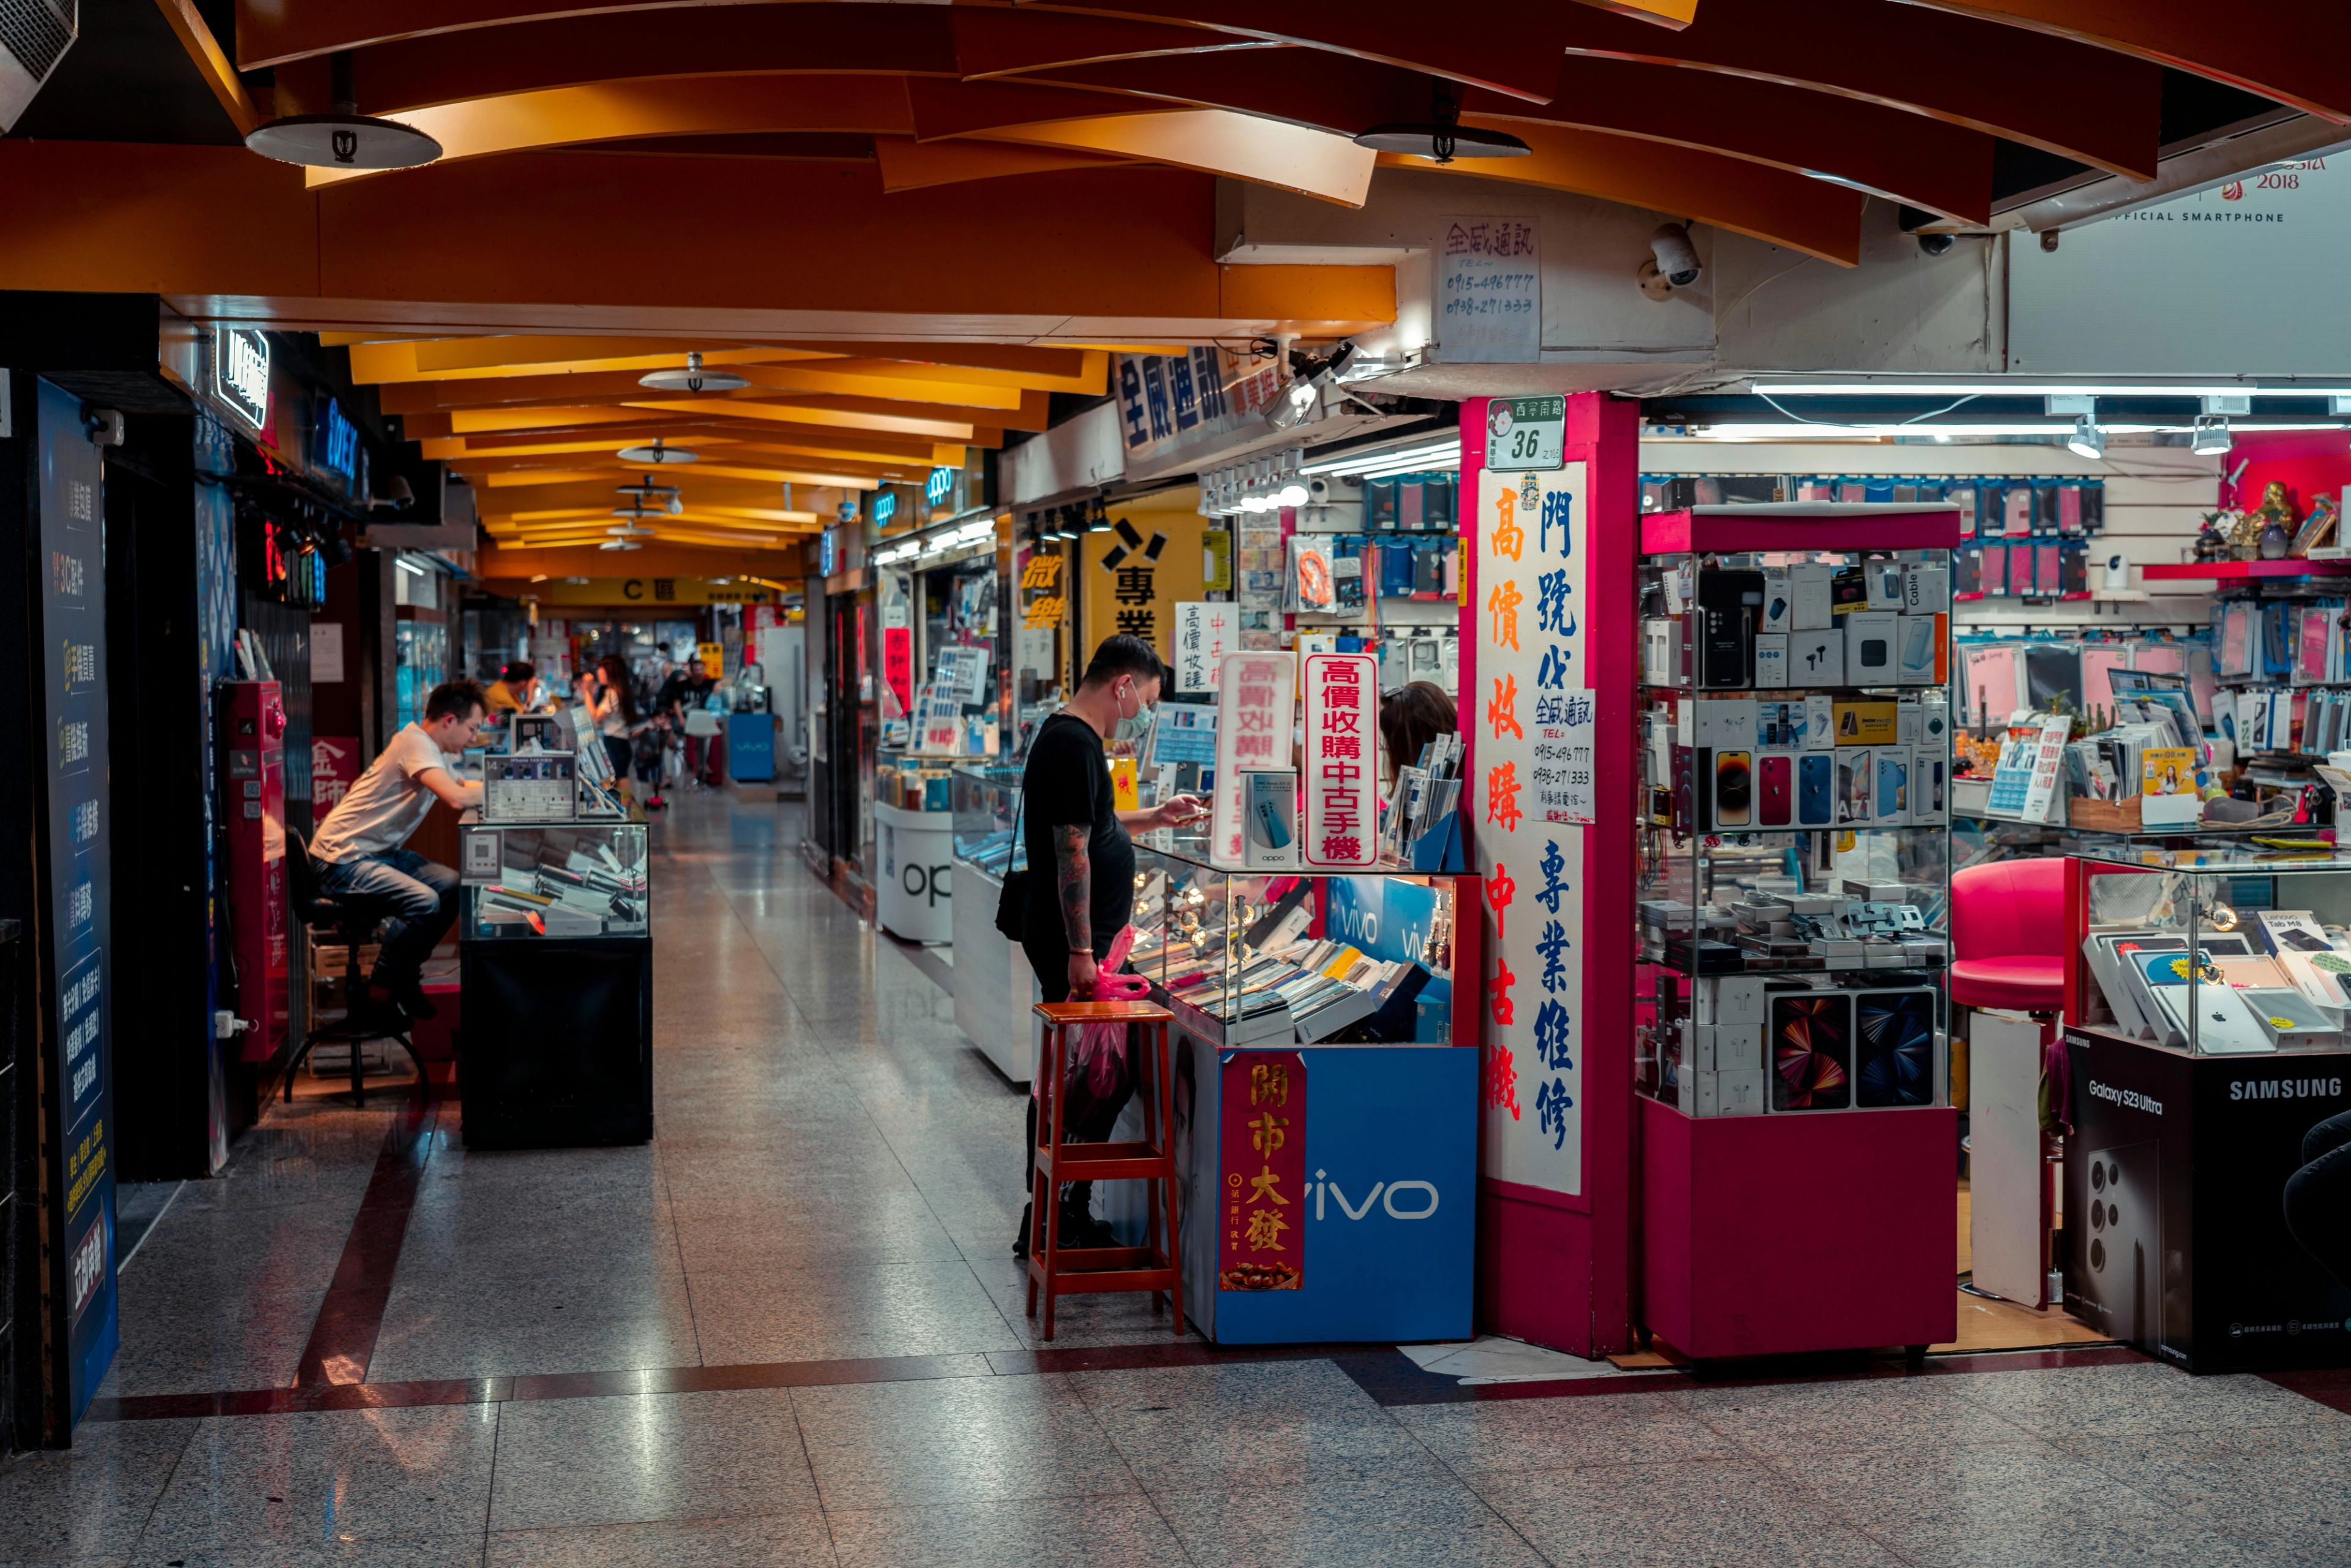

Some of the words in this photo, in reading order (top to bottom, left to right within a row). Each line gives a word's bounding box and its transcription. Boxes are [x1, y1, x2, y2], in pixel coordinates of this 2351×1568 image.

[2257, 174, 2300, 190] 2018
[2183, 212, 2284, 222] SMARTPHONE
[1445, 222, 1534, 257] 全威通訊
[1447, 273, 1534, 293] 0915-496777
[1446, 297, 1532, 315] 0938-271333
[1516, 399, 1562, 417] 西寧南路
[1512, 429, 1540, 459] 36
[1909, 573, 1919, 606] Cable
[1183, 605, 1205, 691] 高價收購
[1535, 694, 1593, 727] 全威通訊
[1320, 661, 1362, 861] 高價收購中古手機
[1535, 744, 1590, 763] 0915-496777
[1533, 767, 1589, 786] 0938-271333
[1484, 487, 1524, 1121] 高價收購中古機
[1341, 898, 1378, 945] vivo
[1402, 921, 1429, 962] viv
[1534, 839, 1574, 1152] 專業維修
[1303, 1025, 1312, 1040] vivo
[1369, 1026, 1382, 1038] vivo
[2065, 1034, 2091, 1049] SAMSUNG
[2089, 1079, 2123, 1107] Galaxy
[2123, 1089, 2139, 1109] S23
[2140, 1094, 2163, 1116] Ultra
[2230, 1078, 2342, 1100] SAMSUNG
[1244, 1063, 1291, 1252] 開市大發
[1230, 1189, 1240, 1225] 第一銀行
[1304, 1168, 1439, 1221] ivo
[2161, 1344, 2188, 1360] samsung.com
